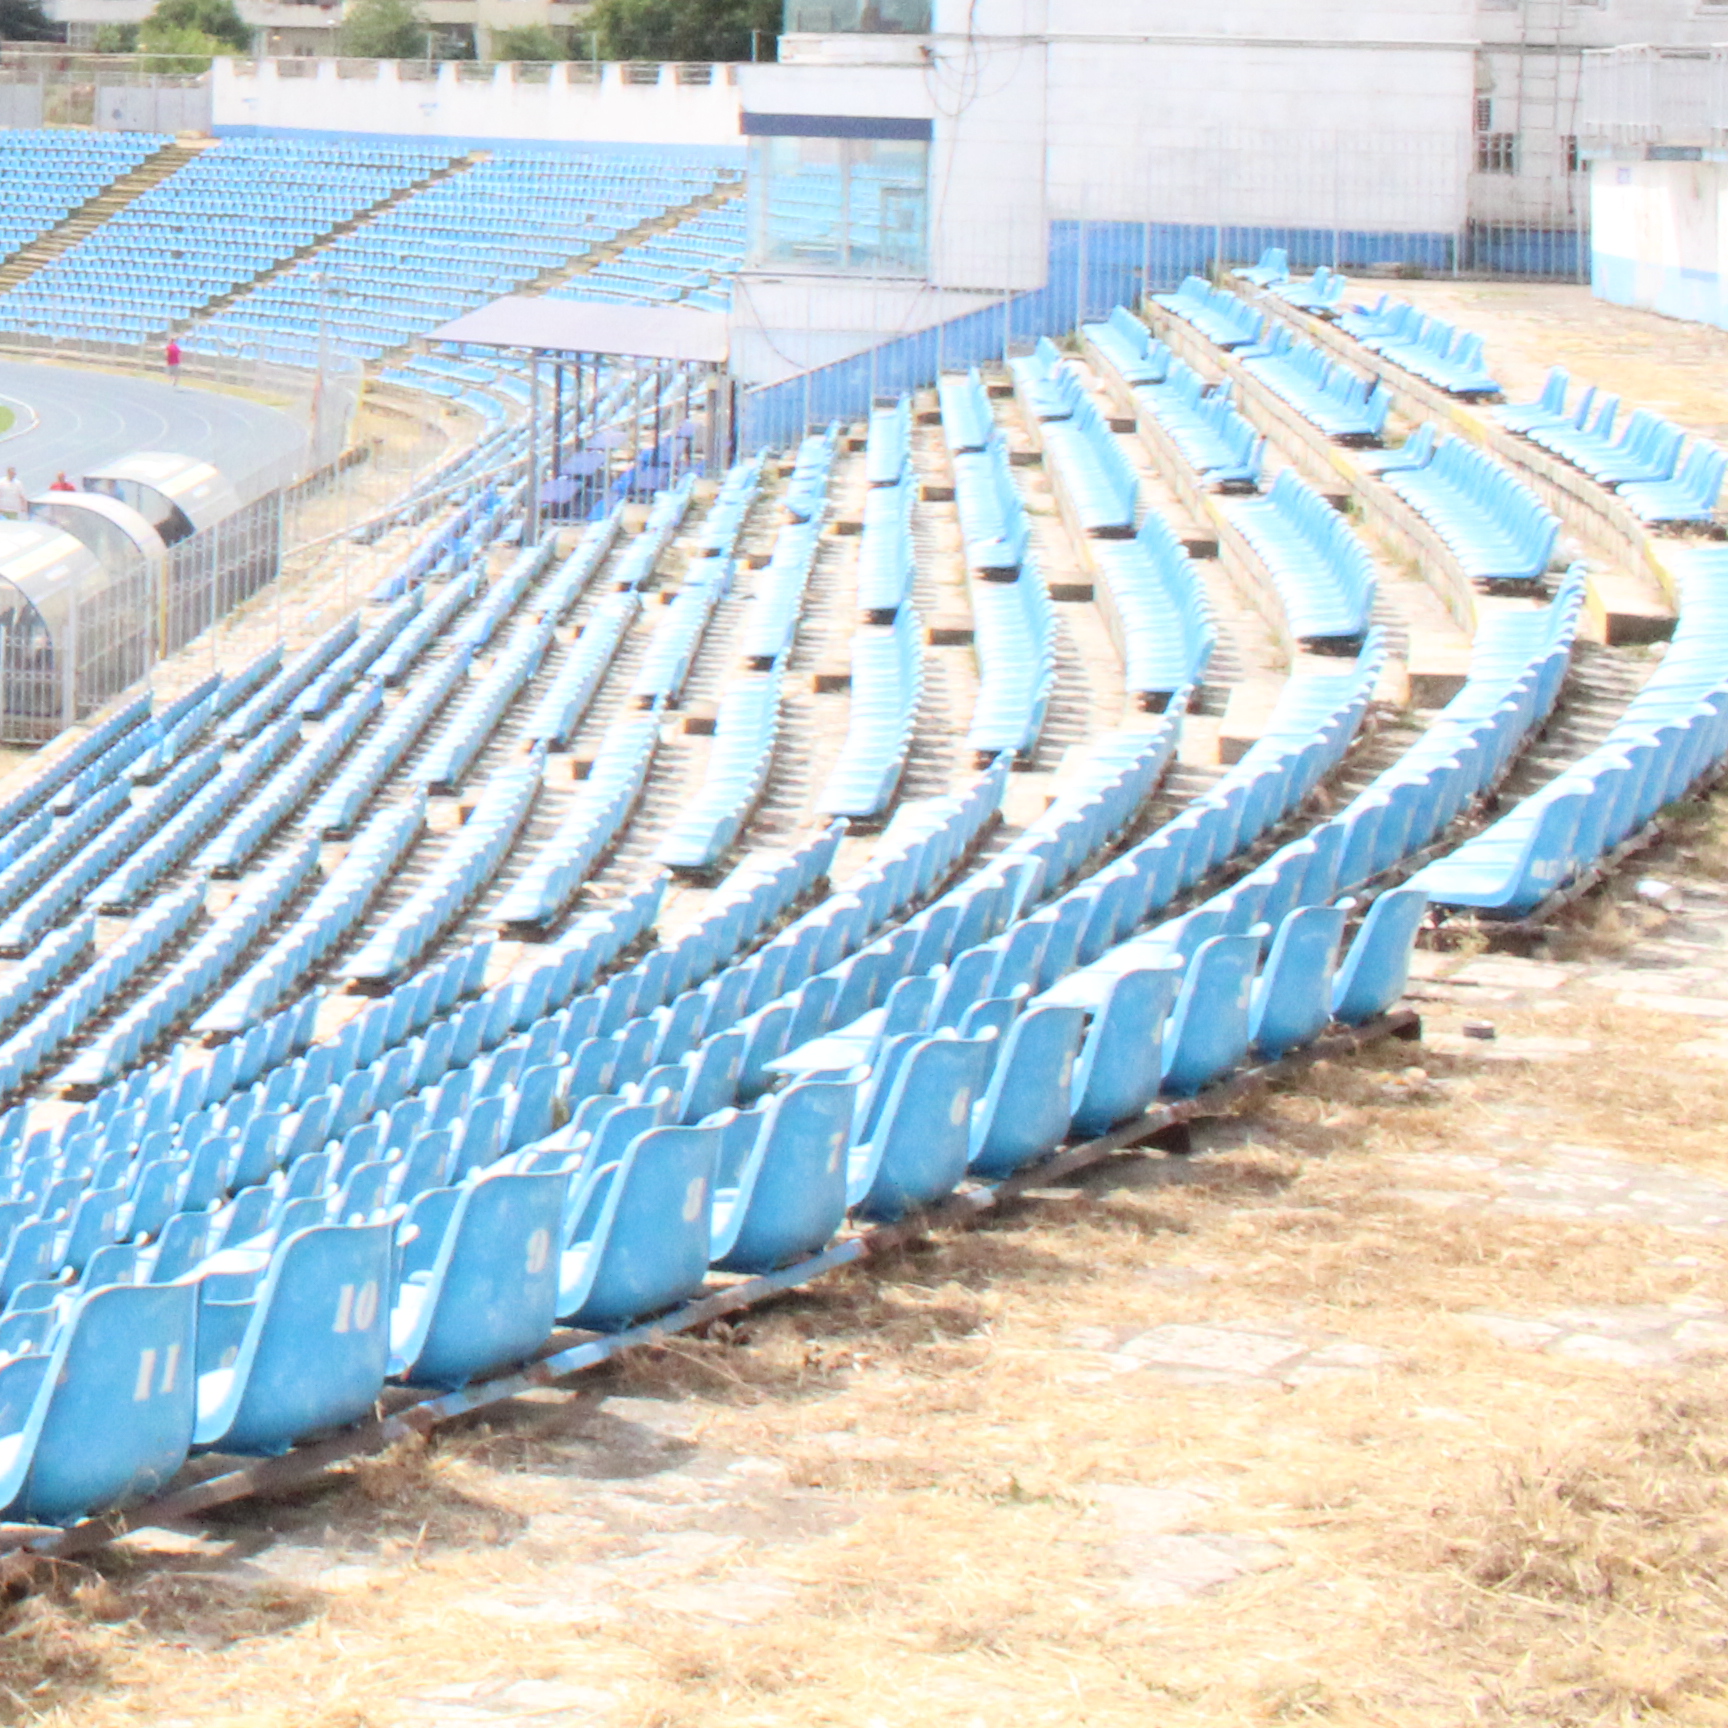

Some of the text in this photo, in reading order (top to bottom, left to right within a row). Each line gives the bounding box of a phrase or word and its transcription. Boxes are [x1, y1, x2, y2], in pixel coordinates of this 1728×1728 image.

[827, 1132, 844, 1174] 7
[526, 1227, 547, 1274] 9
[332, 1280, 378, 1334] 10
[133, 1343, 181, 1401] 11
